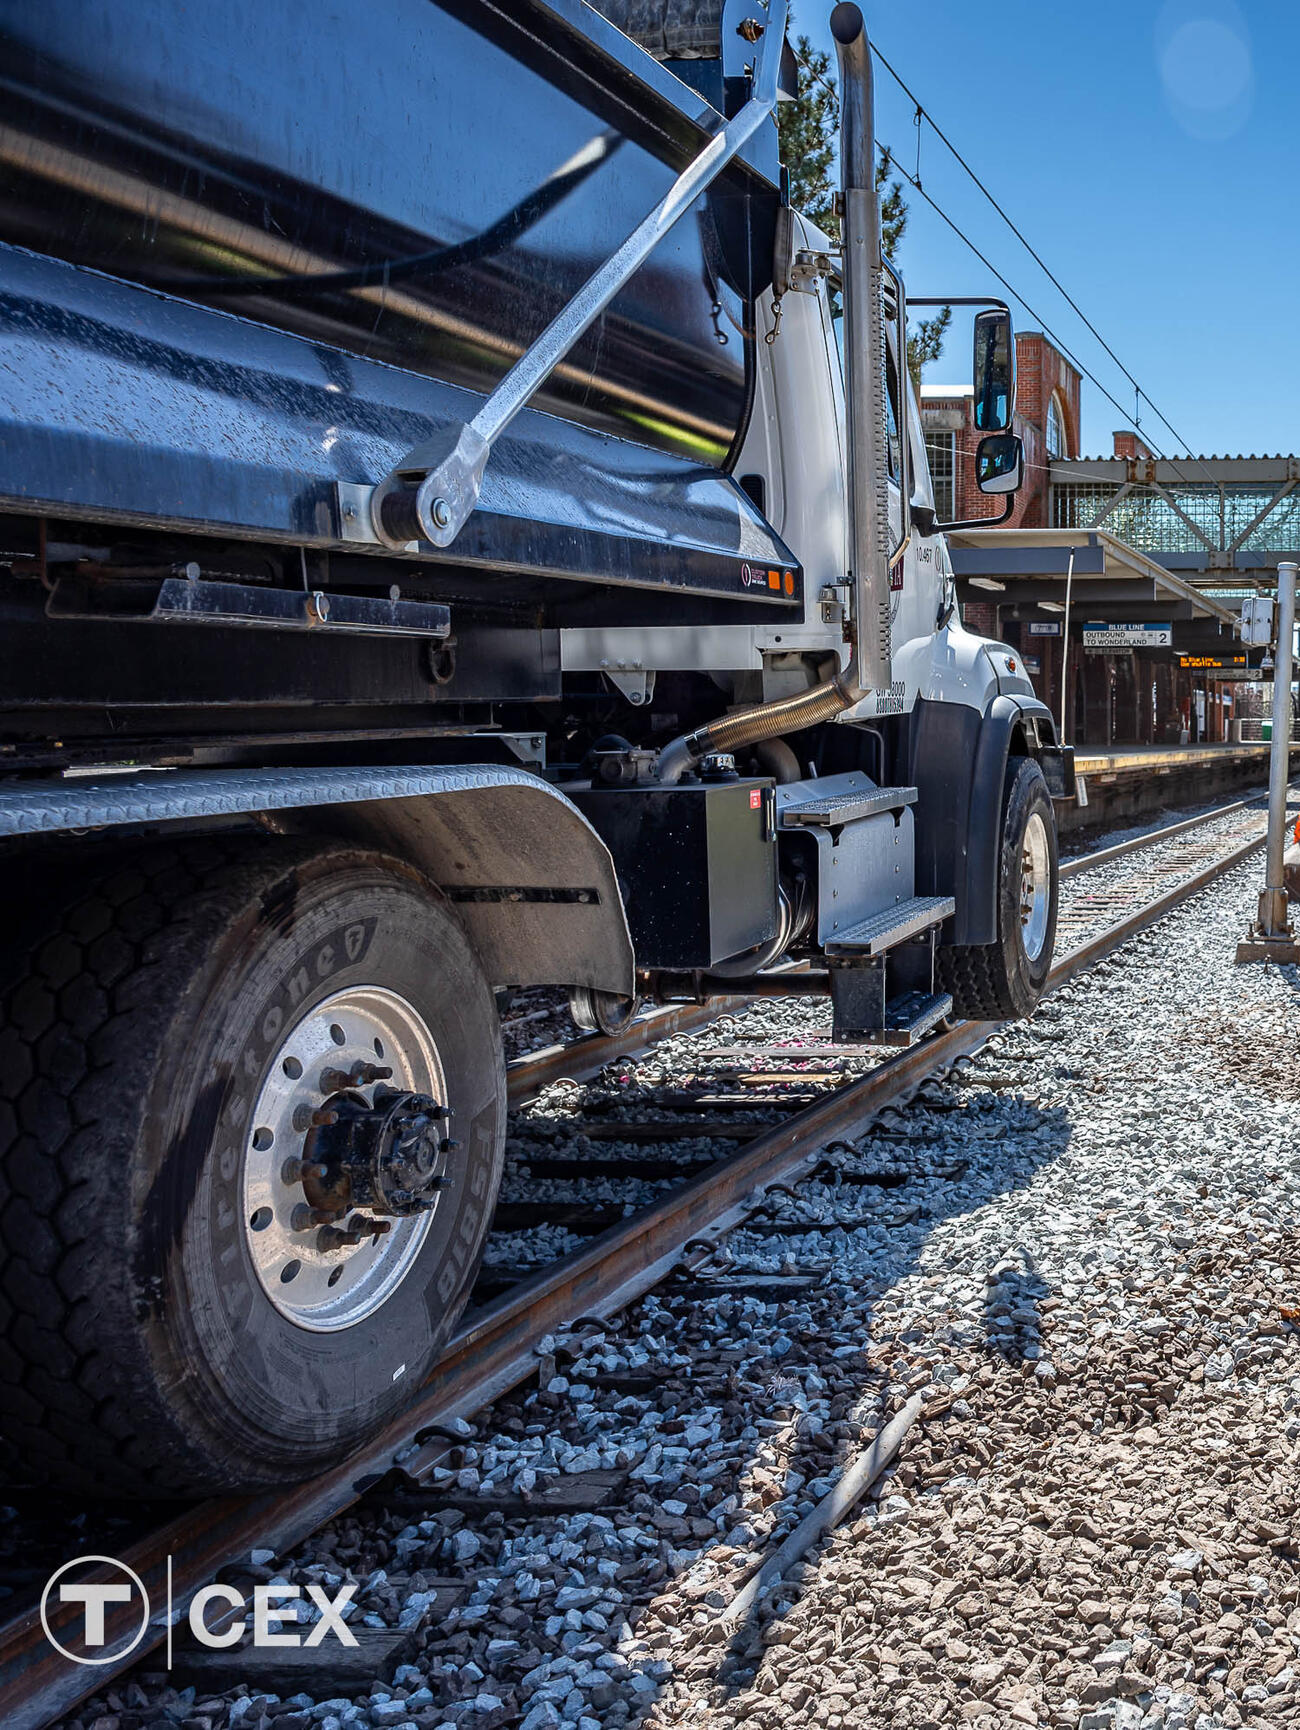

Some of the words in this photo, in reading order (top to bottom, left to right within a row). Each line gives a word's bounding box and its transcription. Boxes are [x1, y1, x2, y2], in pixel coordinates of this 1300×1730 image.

[1086, 631, 1125, 639] OUTBOUND
[1159, 633, 1167, 644] 2
[1254, 670, 1260, 678] 2
